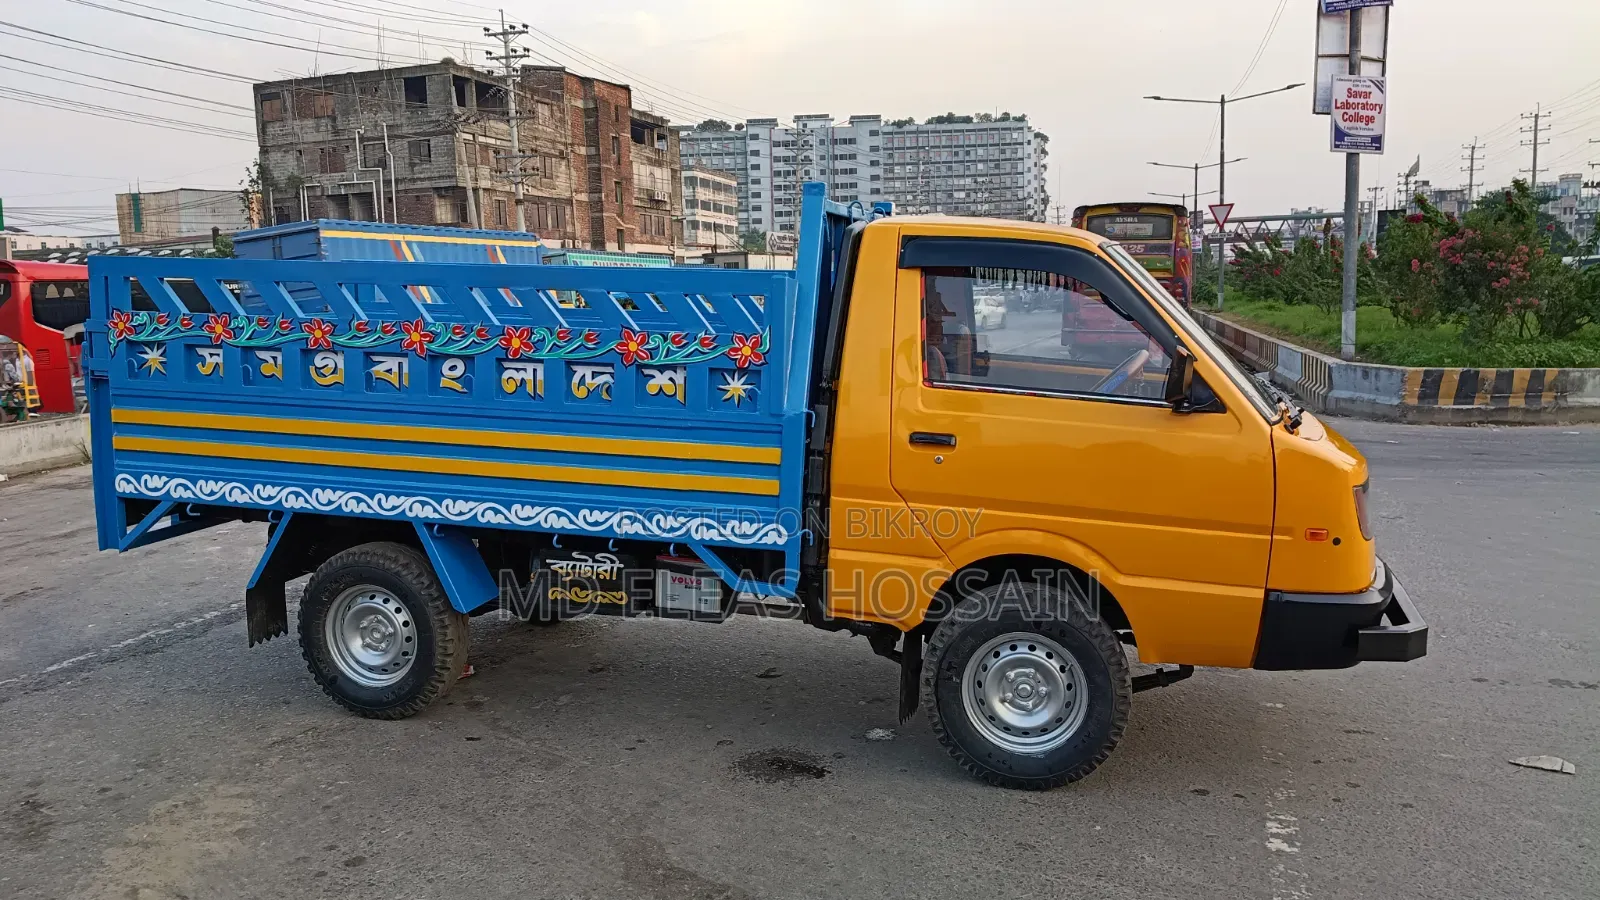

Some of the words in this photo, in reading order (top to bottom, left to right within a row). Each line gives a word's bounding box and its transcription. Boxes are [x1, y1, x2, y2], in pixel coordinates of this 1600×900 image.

[1346, 87, 1372, 99] Savar
[1334, 98, 1383, 114] Laboratory
[1342, 112, 1375, 126] College
[671, 576, 702, 585] VOLVO
